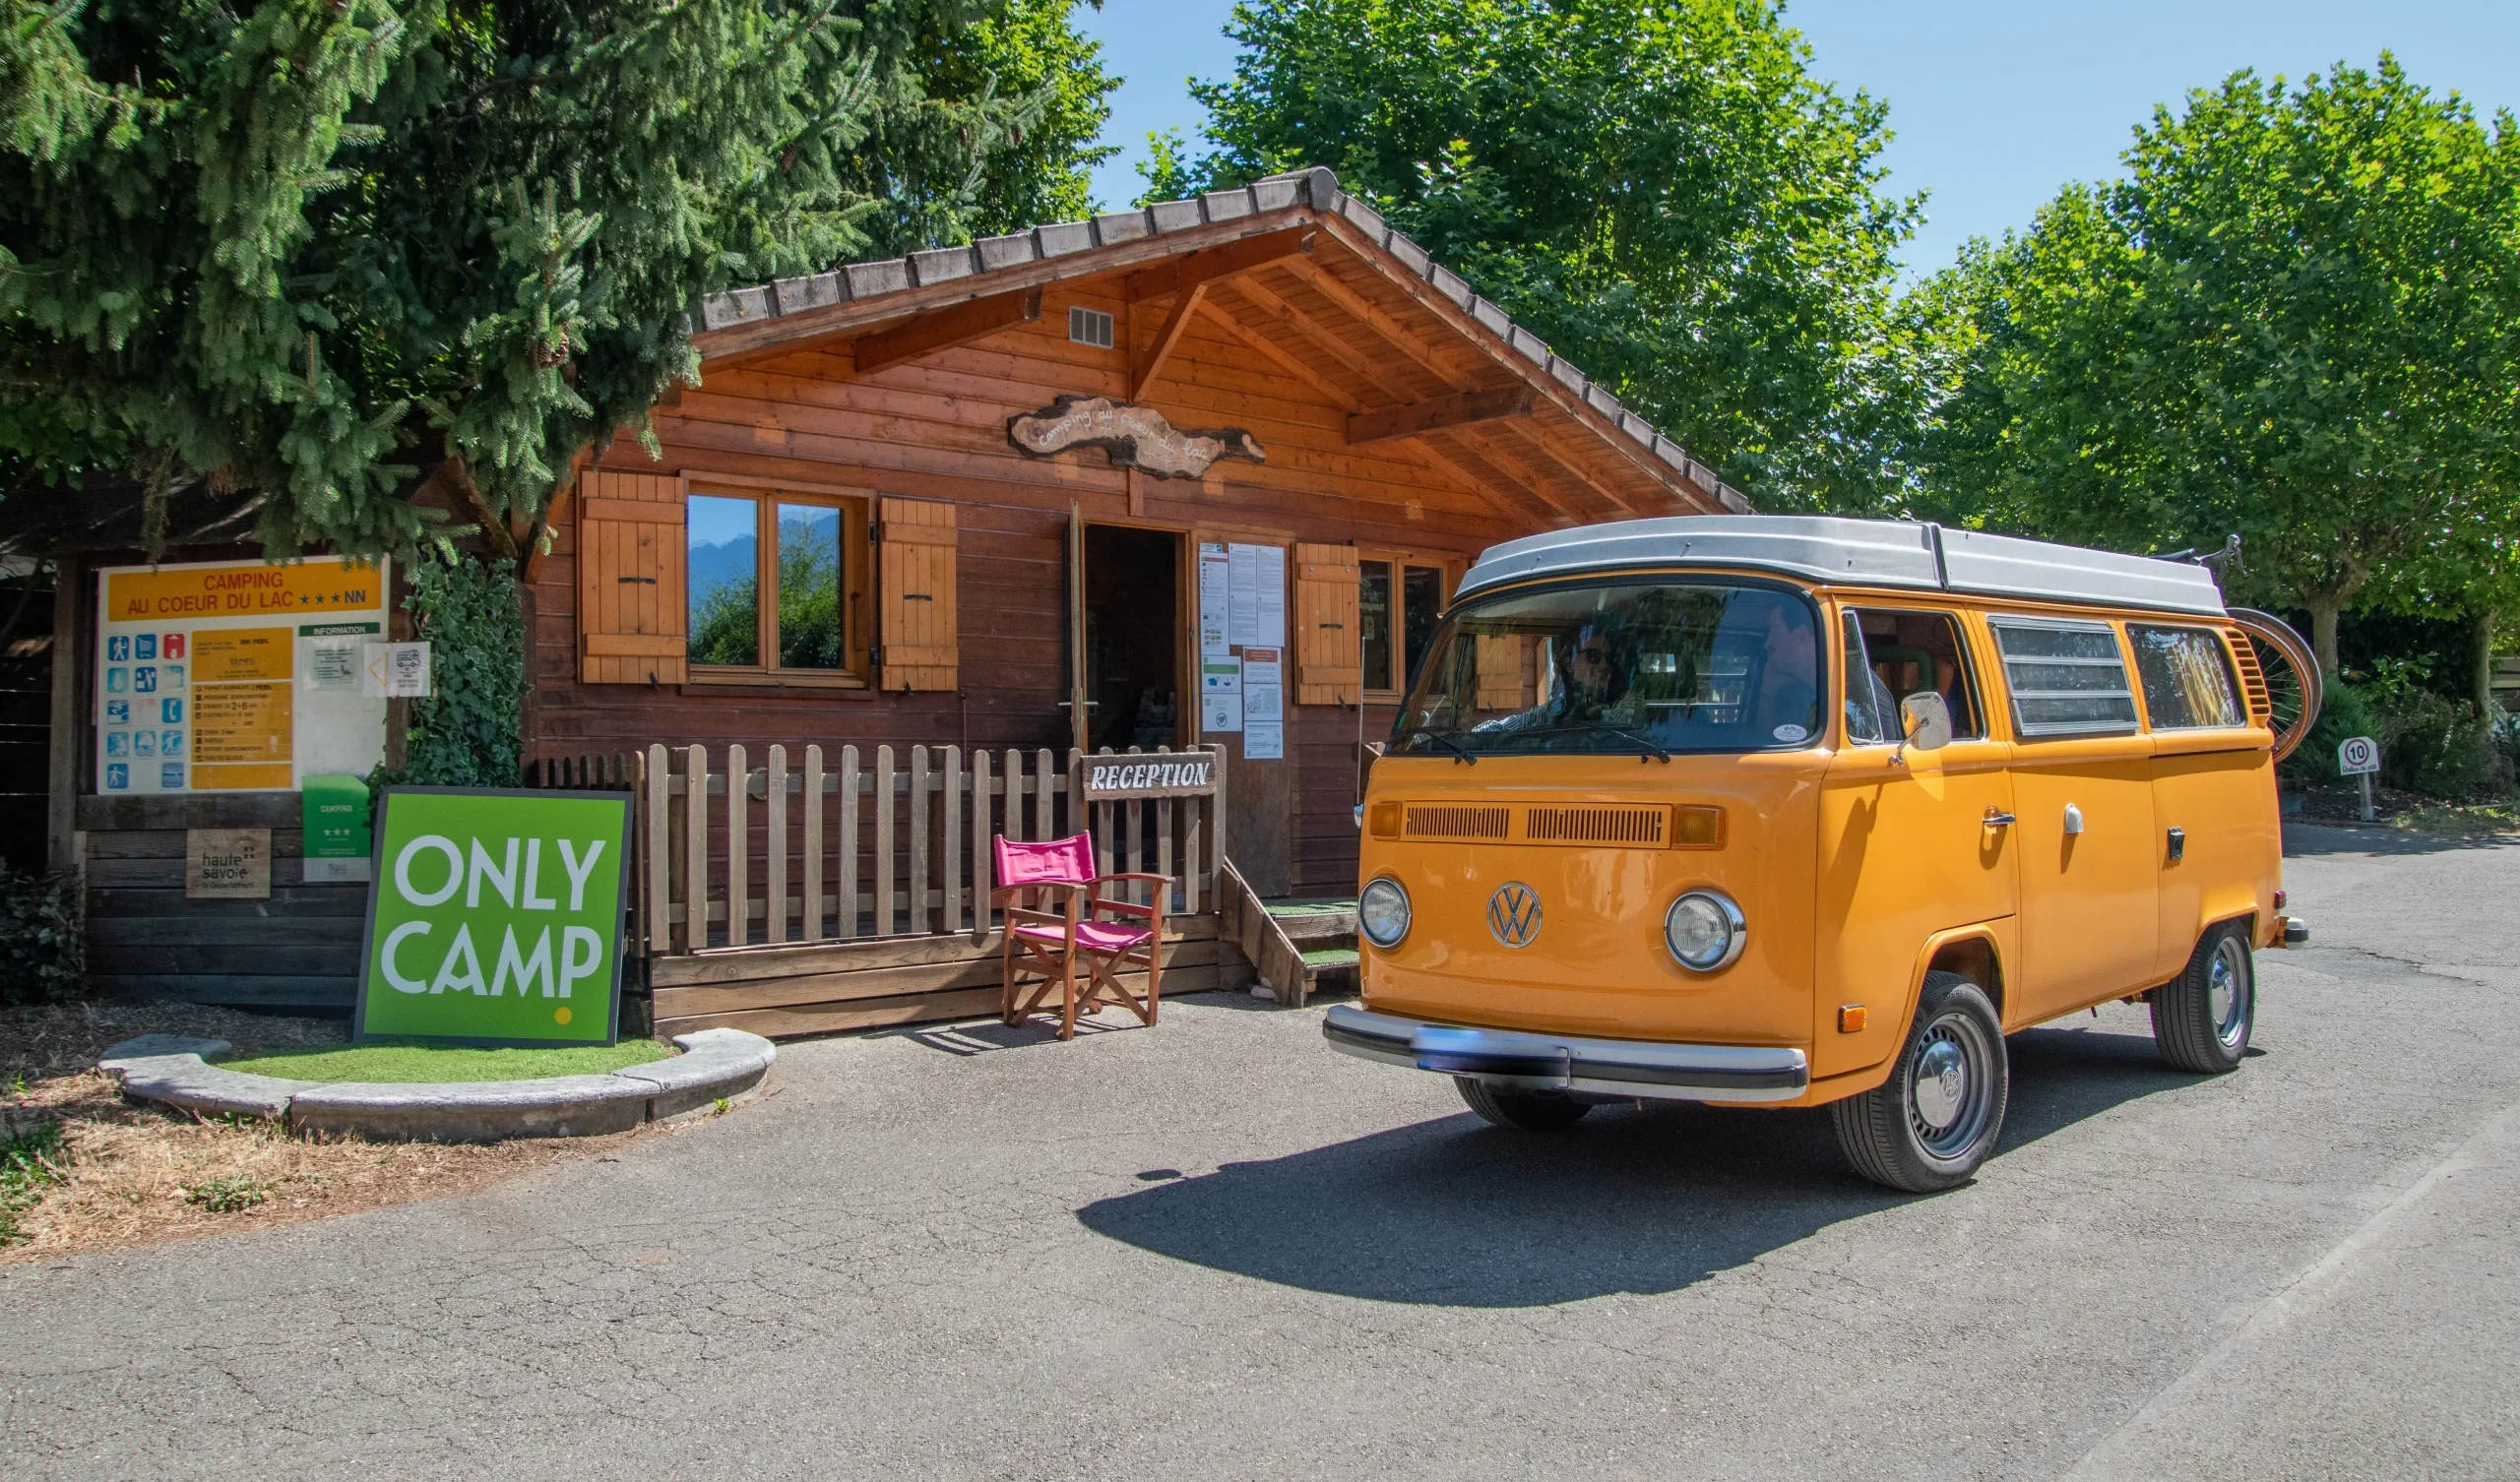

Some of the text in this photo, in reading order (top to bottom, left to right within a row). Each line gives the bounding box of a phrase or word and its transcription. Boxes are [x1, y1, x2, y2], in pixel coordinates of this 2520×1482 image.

[1159, 436, 1174, 454] du
[1182, 438, 1208, 459] lac
[204, 572, 284, 590] CAMPING
[128, 590, 366, 615] AU COEUR DU LAC NN
[313, 626, 366, 636] INFORMATION
[231, 702, 237, 710] 2
[241, 702, 248, 710] 6
[2350, 745, 2364, 760] 10
[1091, 762, 1210, 790] RECEPTION
[320, 804, 353, 813] CAMPING
[202, 852, 242, 866] haute
[202, 868, 248, 879] savoie
[395, 834, 607, 911] ONLY
[381, 920, 603, 999] CAMP
